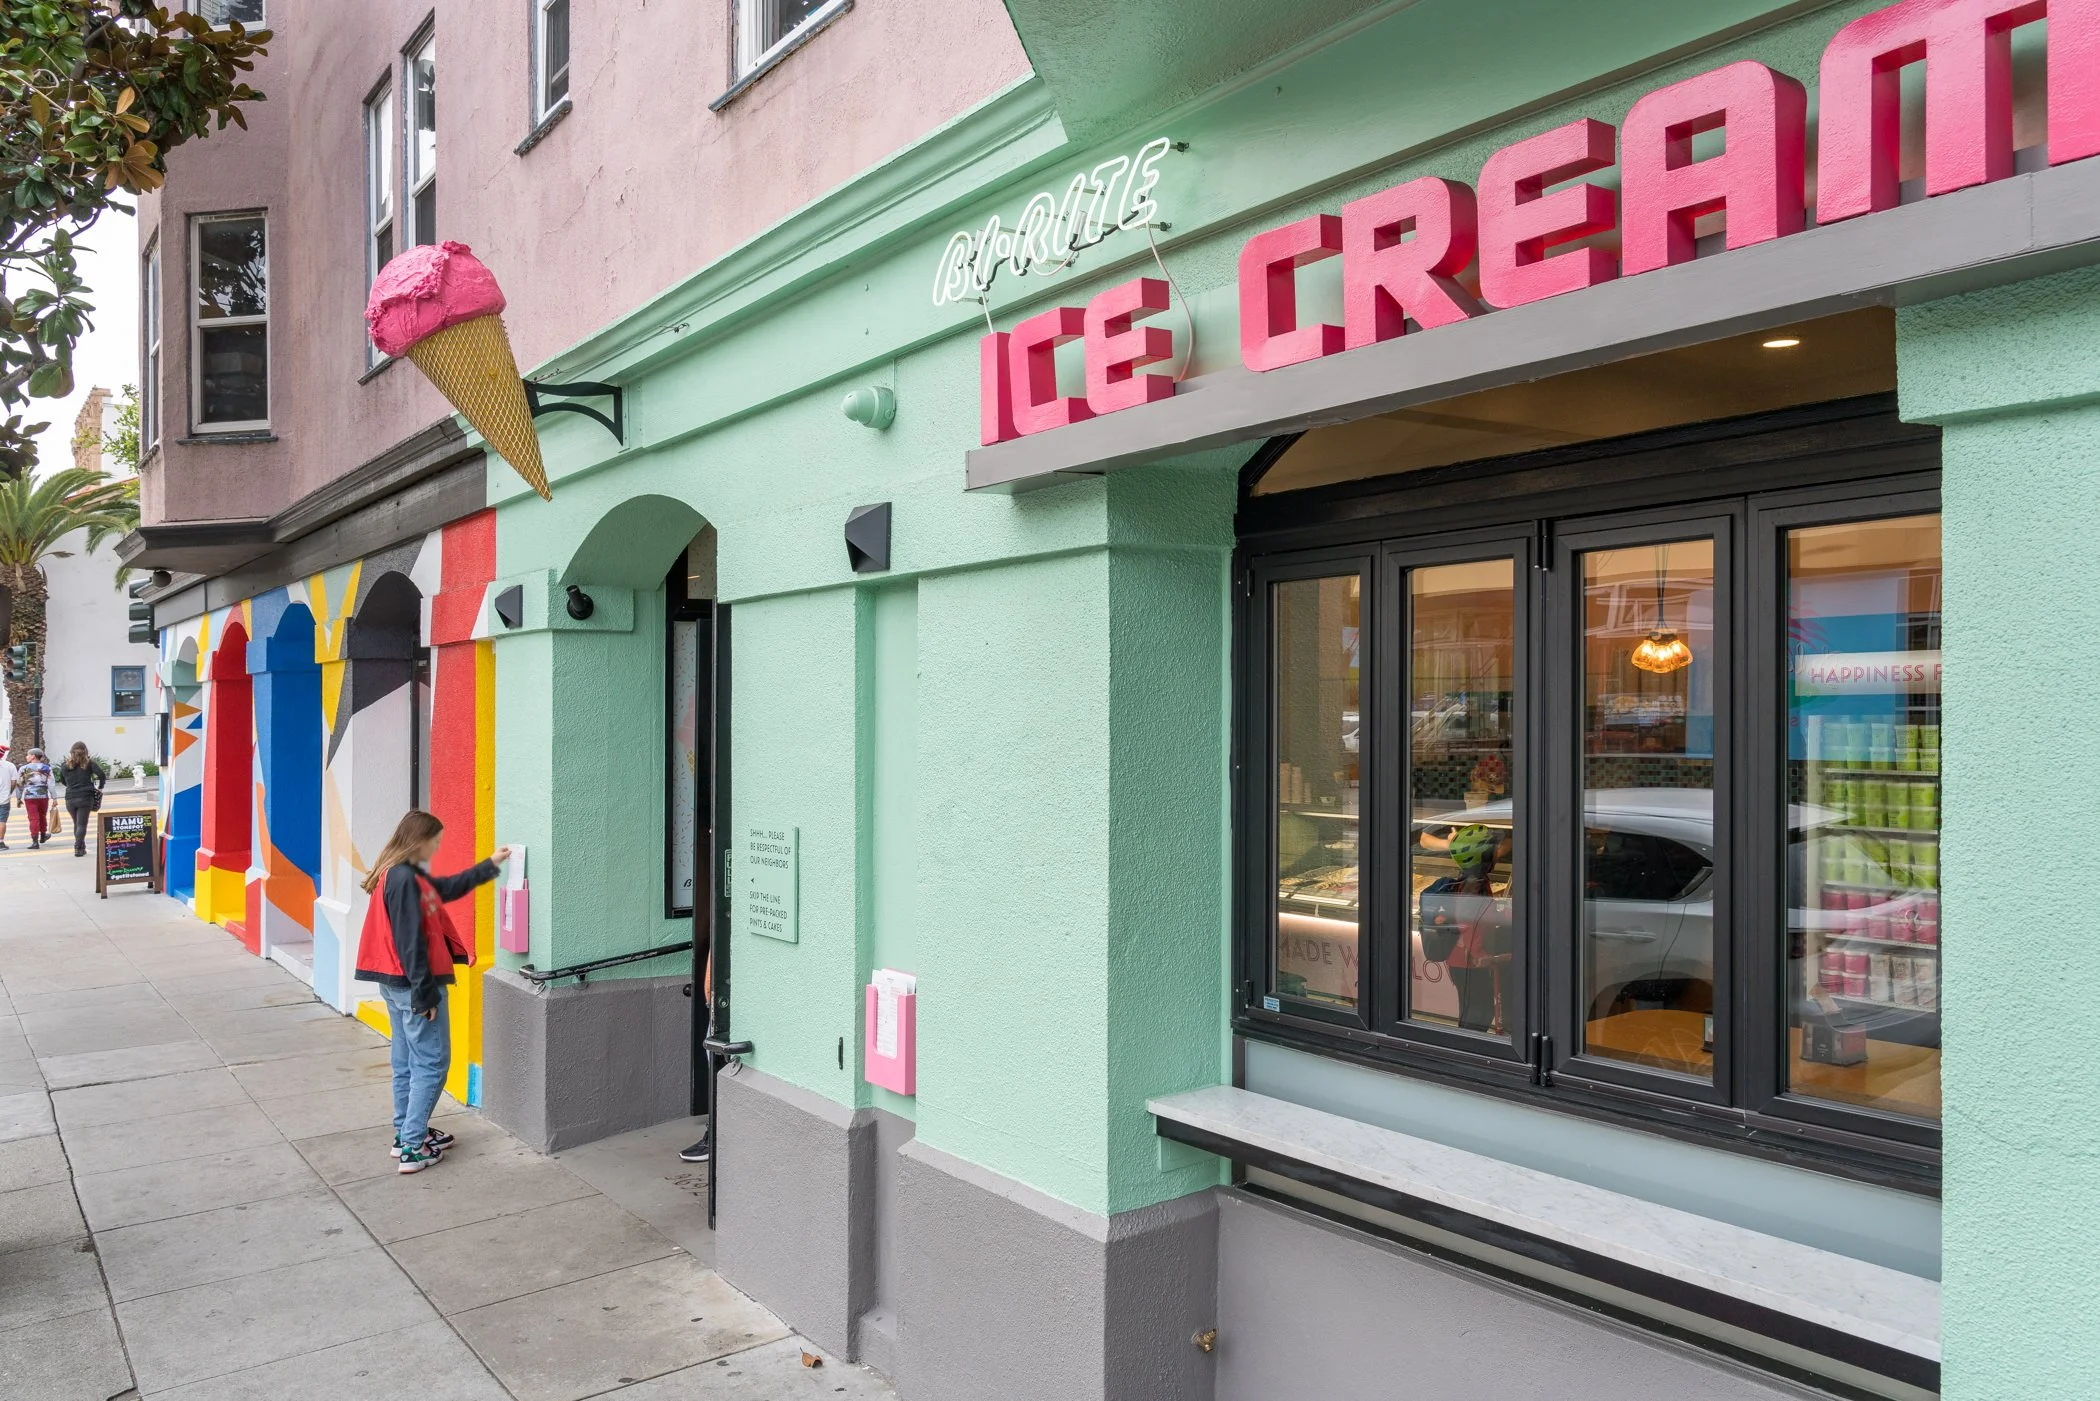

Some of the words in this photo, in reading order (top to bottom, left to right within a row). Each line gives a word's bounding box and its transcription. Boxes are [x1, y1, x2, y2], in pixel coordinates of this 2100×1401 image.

[980, 277, 1175, 447] ICE
[1238, 0, 2100, 372] CREAM
[1811, 664, 1925, 684] HAPPINESS
[112, 817, 144, 826] NAMU
[768, 830, 785, 841] PLEASE
[750, 842, 756, 850] BE
[757, 842, 783, 855] RESPECTFUL
[784, 846, 791, 855] OF
[750, 855, 760, 864] OUR
[761, 857, 789, 869] NEIGHBORS
[749, 890, 759, 900] SKIP
[760, 892, 769, 902] THE
[770, 894, 781, 904] LINE
[750, 904, 759, 913] FOR
[760, 906, 788, 919] PRE-PACKED
[750, 917, 762, 928] PINTS
[768, 921, 783, 932] CAKES
